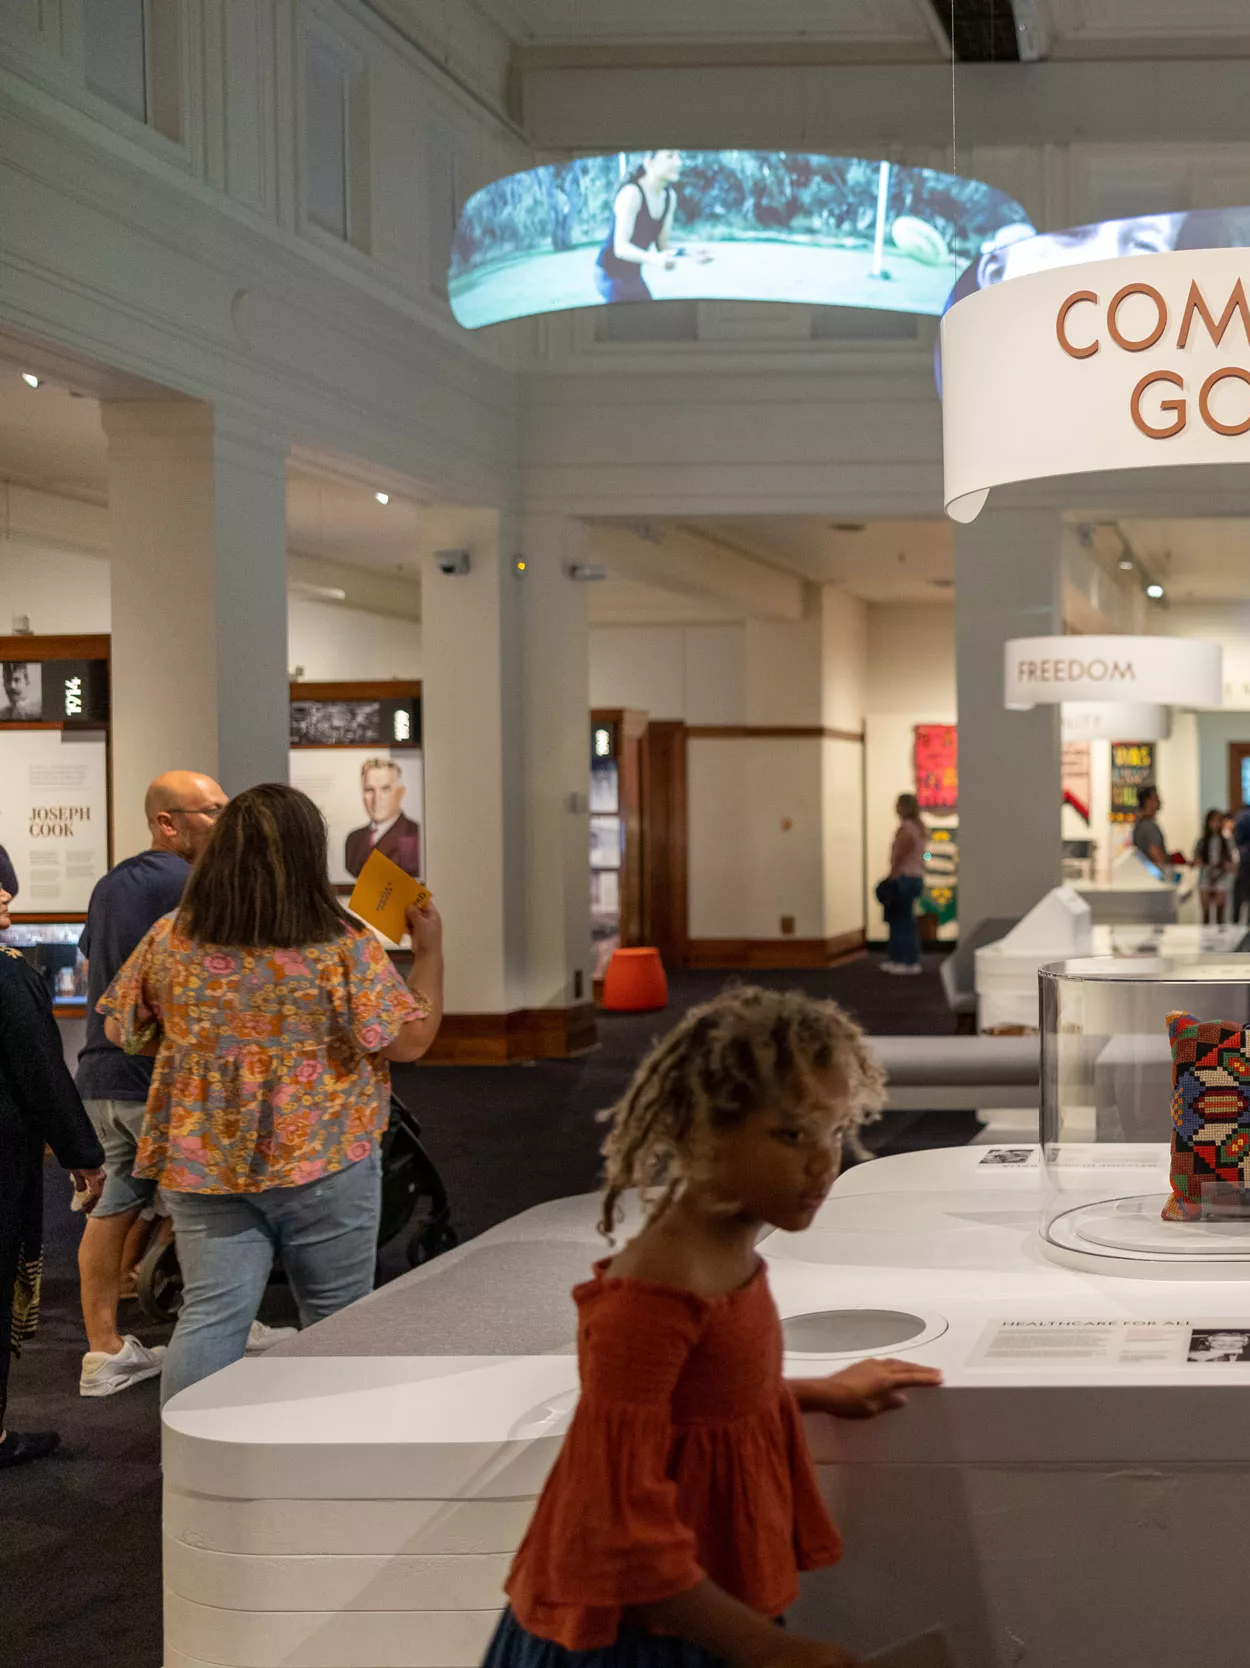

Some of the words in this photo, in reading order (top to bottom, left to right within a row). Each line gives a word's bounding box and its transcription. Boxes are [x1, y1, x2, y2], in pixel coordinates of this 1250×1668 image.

[1018, 659, 1136, 682] FREEDOM
[65, 676, 83, 717] 1914
[29, 806, 91, 822] JOSEPH
[30, 822, 74, 838] COOK
